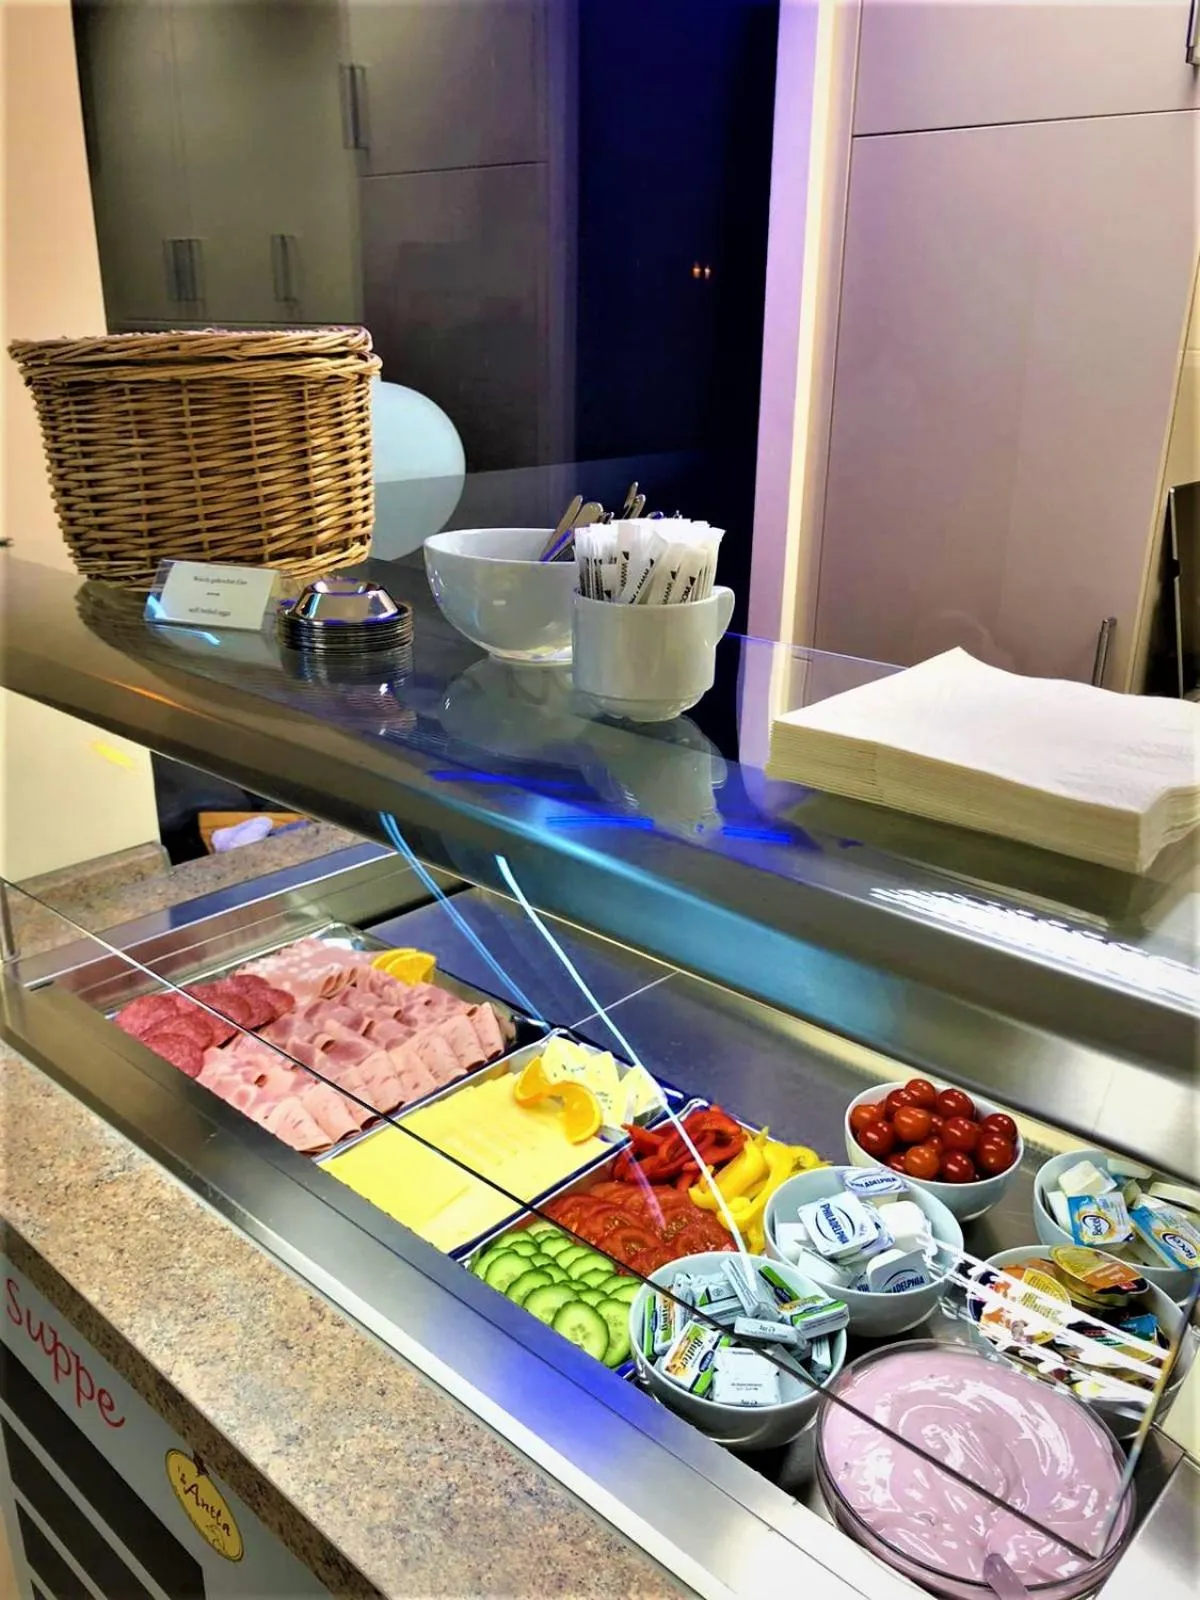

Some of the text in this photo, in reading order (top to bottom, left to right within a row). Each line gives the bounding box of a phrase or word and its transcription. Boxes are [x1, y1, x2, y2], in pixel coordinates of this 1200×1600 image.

[819, 1202, 850, 1246] PHILADELPHIA
[890, 1276, 926, 1293] ADELPHIA
[6, 1277, 126, 1428] Suppe
[680, 1337, 704, 1369] Butter
